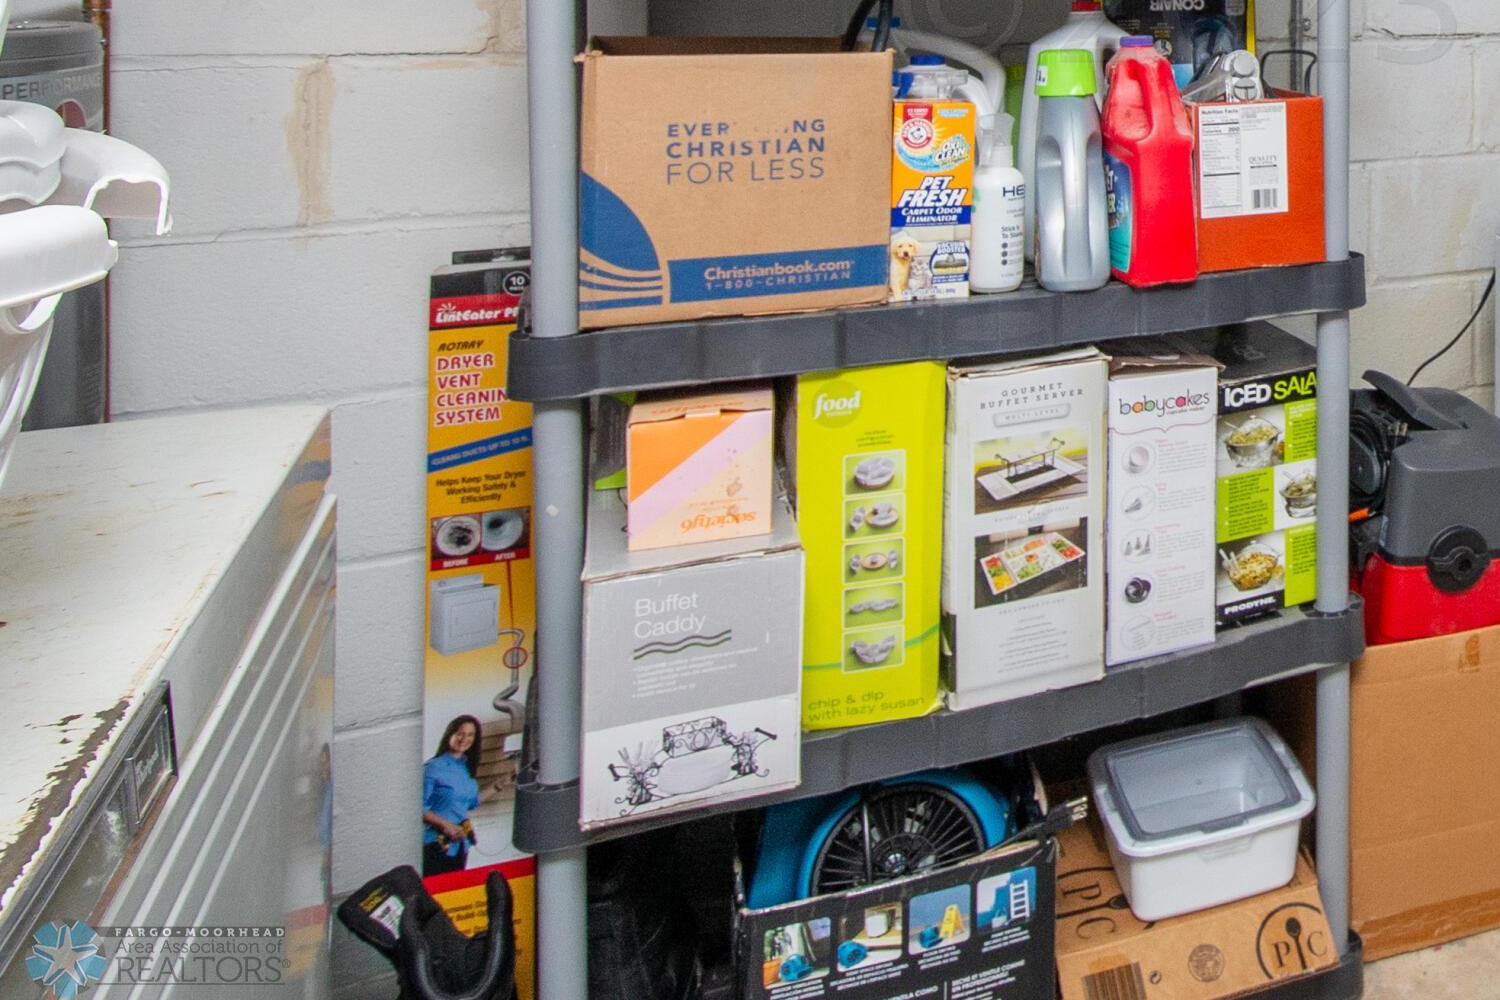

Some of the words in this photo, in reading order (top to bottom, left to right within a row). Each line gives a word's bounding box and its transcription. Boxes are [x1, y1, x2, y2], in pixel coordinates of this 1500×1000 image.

[666, 137, 825, 159] CHRISTIAN
[666, 161, 735, 186] FOR
[750, 156, 825, 182] LESS
[920, 175, 954, 191] PET
[897, 187, 968, 208] FRESH
[509, 276, 525, 286] 10
[704, 259, 852, 282] Christianbook.com
[705, 269, 851, 291] 1-800-CHRISTIAN
[437, 340, 484, 352] ROTARY
[436, 353, 494, 371] DRYER
[437, 373, 482, 390] VENT
[1001, 382, 1063, 398] GOURMET
[1224, 383, 1272, 408] ICED
[1273, 371, 1317, 400] SALA
[436, 389, 508, 407] CLEANIN
[813, 389, 861, 421] food
[980, 396, 1029, 410] BUFFET
[1035, 388, 1084, 401] SERVER
[1118, 387, 1211, 418] babycakes
[435, 407, 501, 426] SYSTEM
[635, 591, 699, 618] Buffet
[634, 612, 706, 640] Caddy
[807, 697, 841, 711] chip
[861, 689, 884, 702] dip
[807, 708, 841, 722] with
[845, 704, 876, 716] lazy
[880, 696, 925, 711] susan
